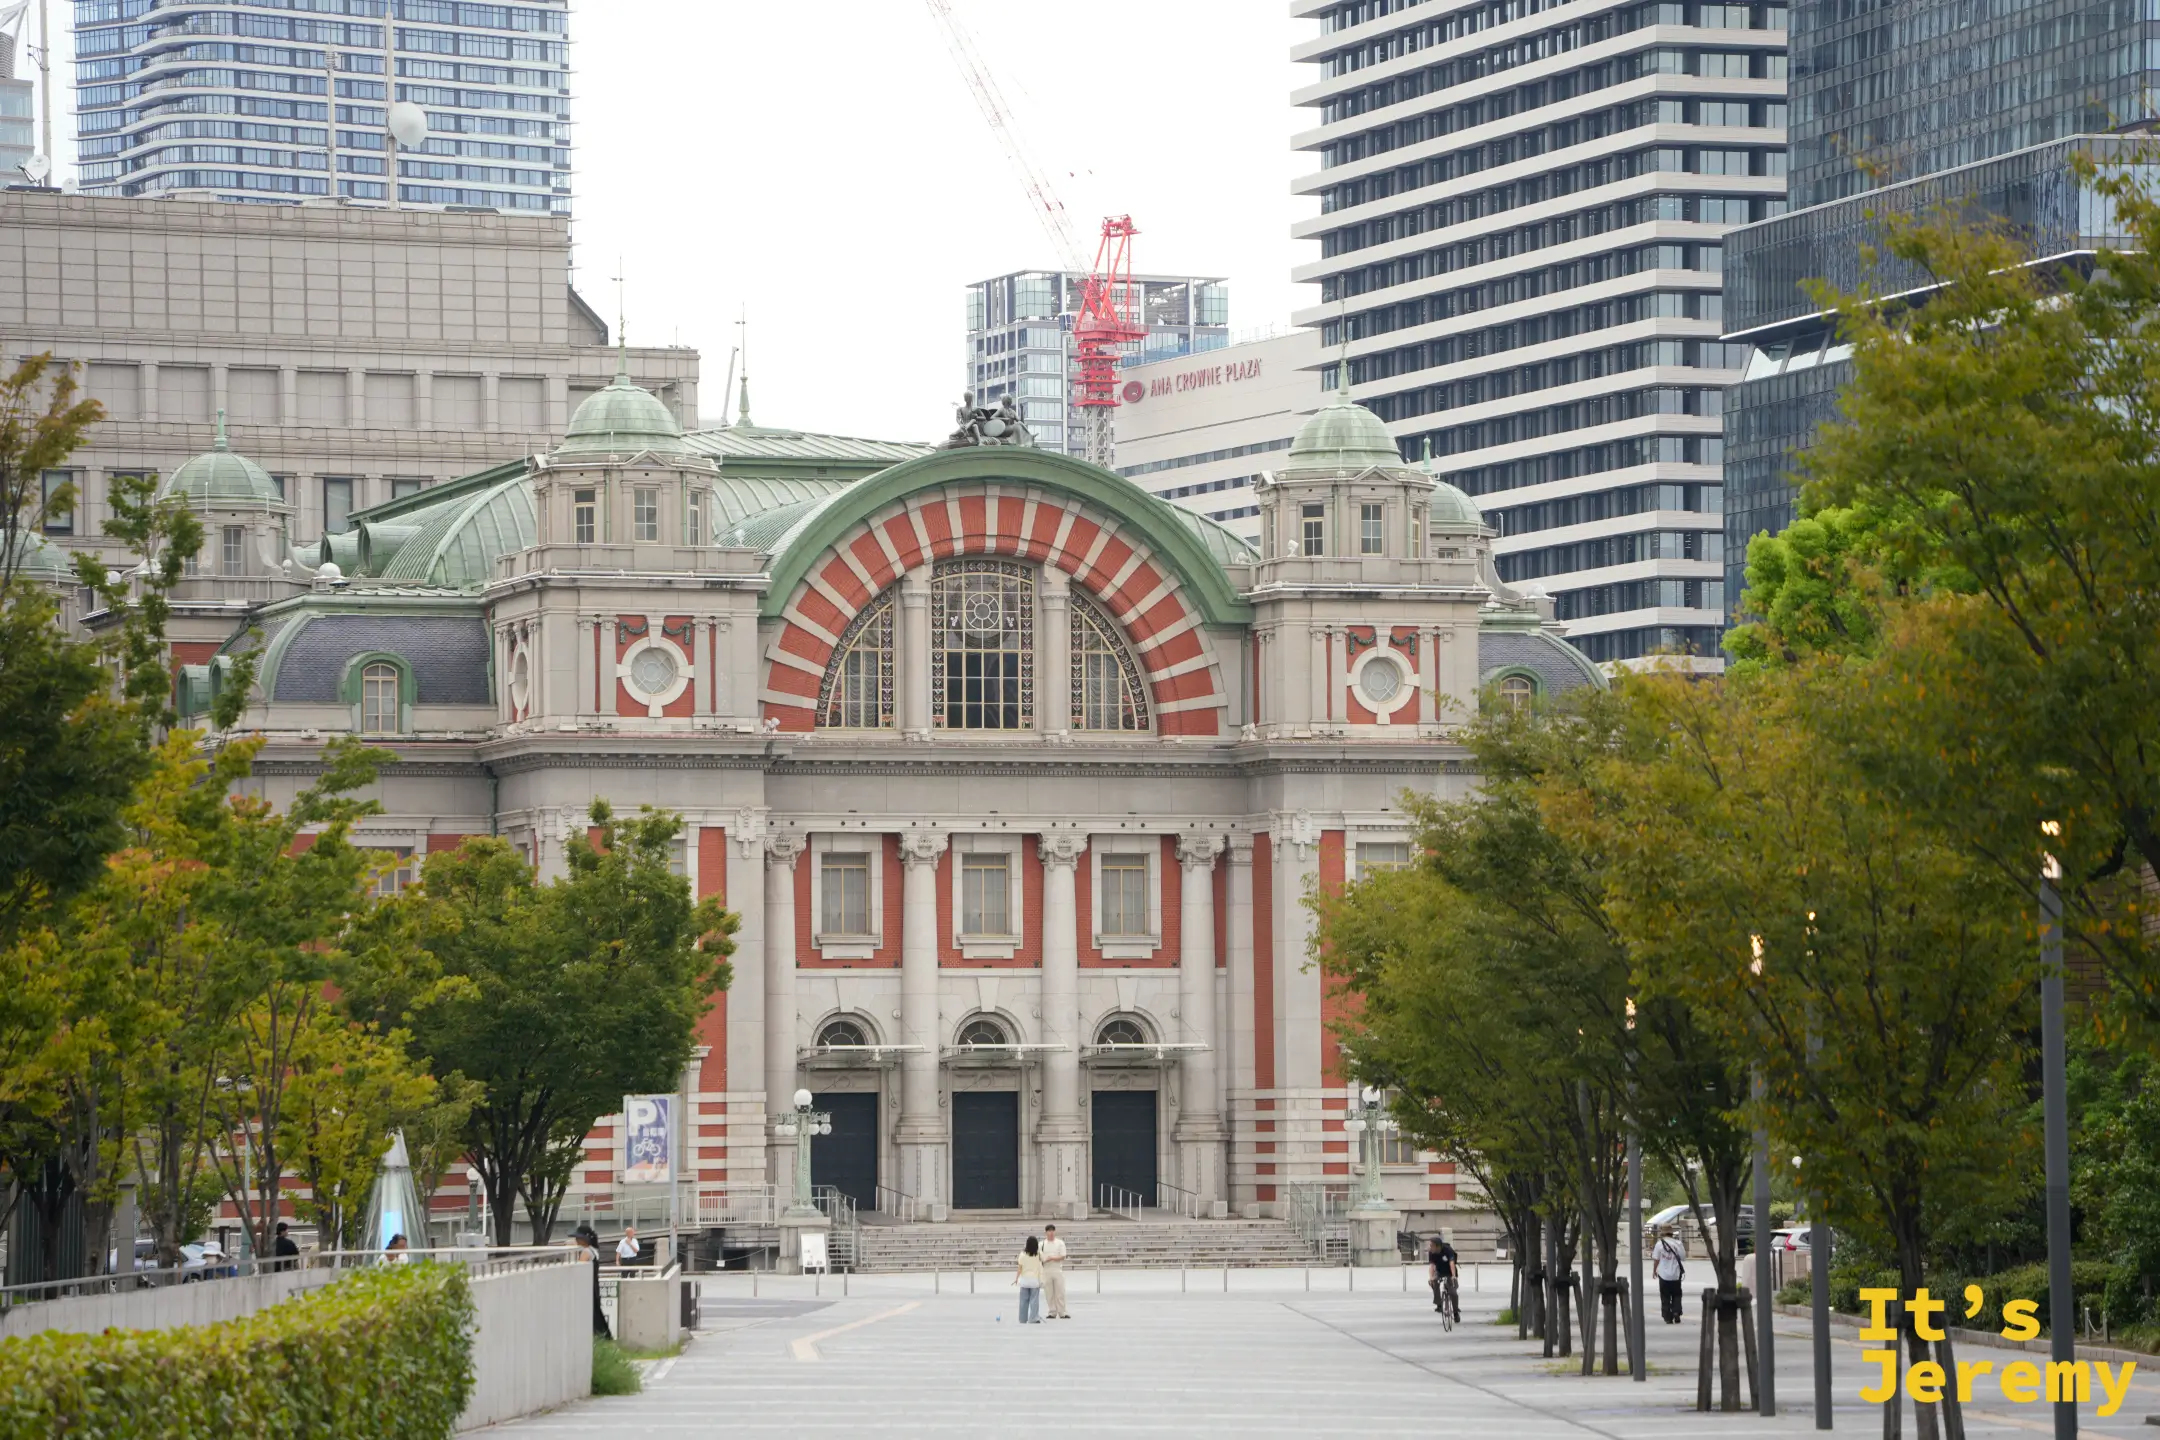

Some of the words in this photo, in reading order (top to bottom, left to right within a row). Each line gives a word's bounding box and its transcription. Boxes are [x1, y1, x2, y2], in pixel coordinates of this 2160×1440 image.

[1150, 376, 1173, 396] ANA
[1176, 366, 1221, 392] CROWNE
[1226, 359, 1261, 383] PLAZA
